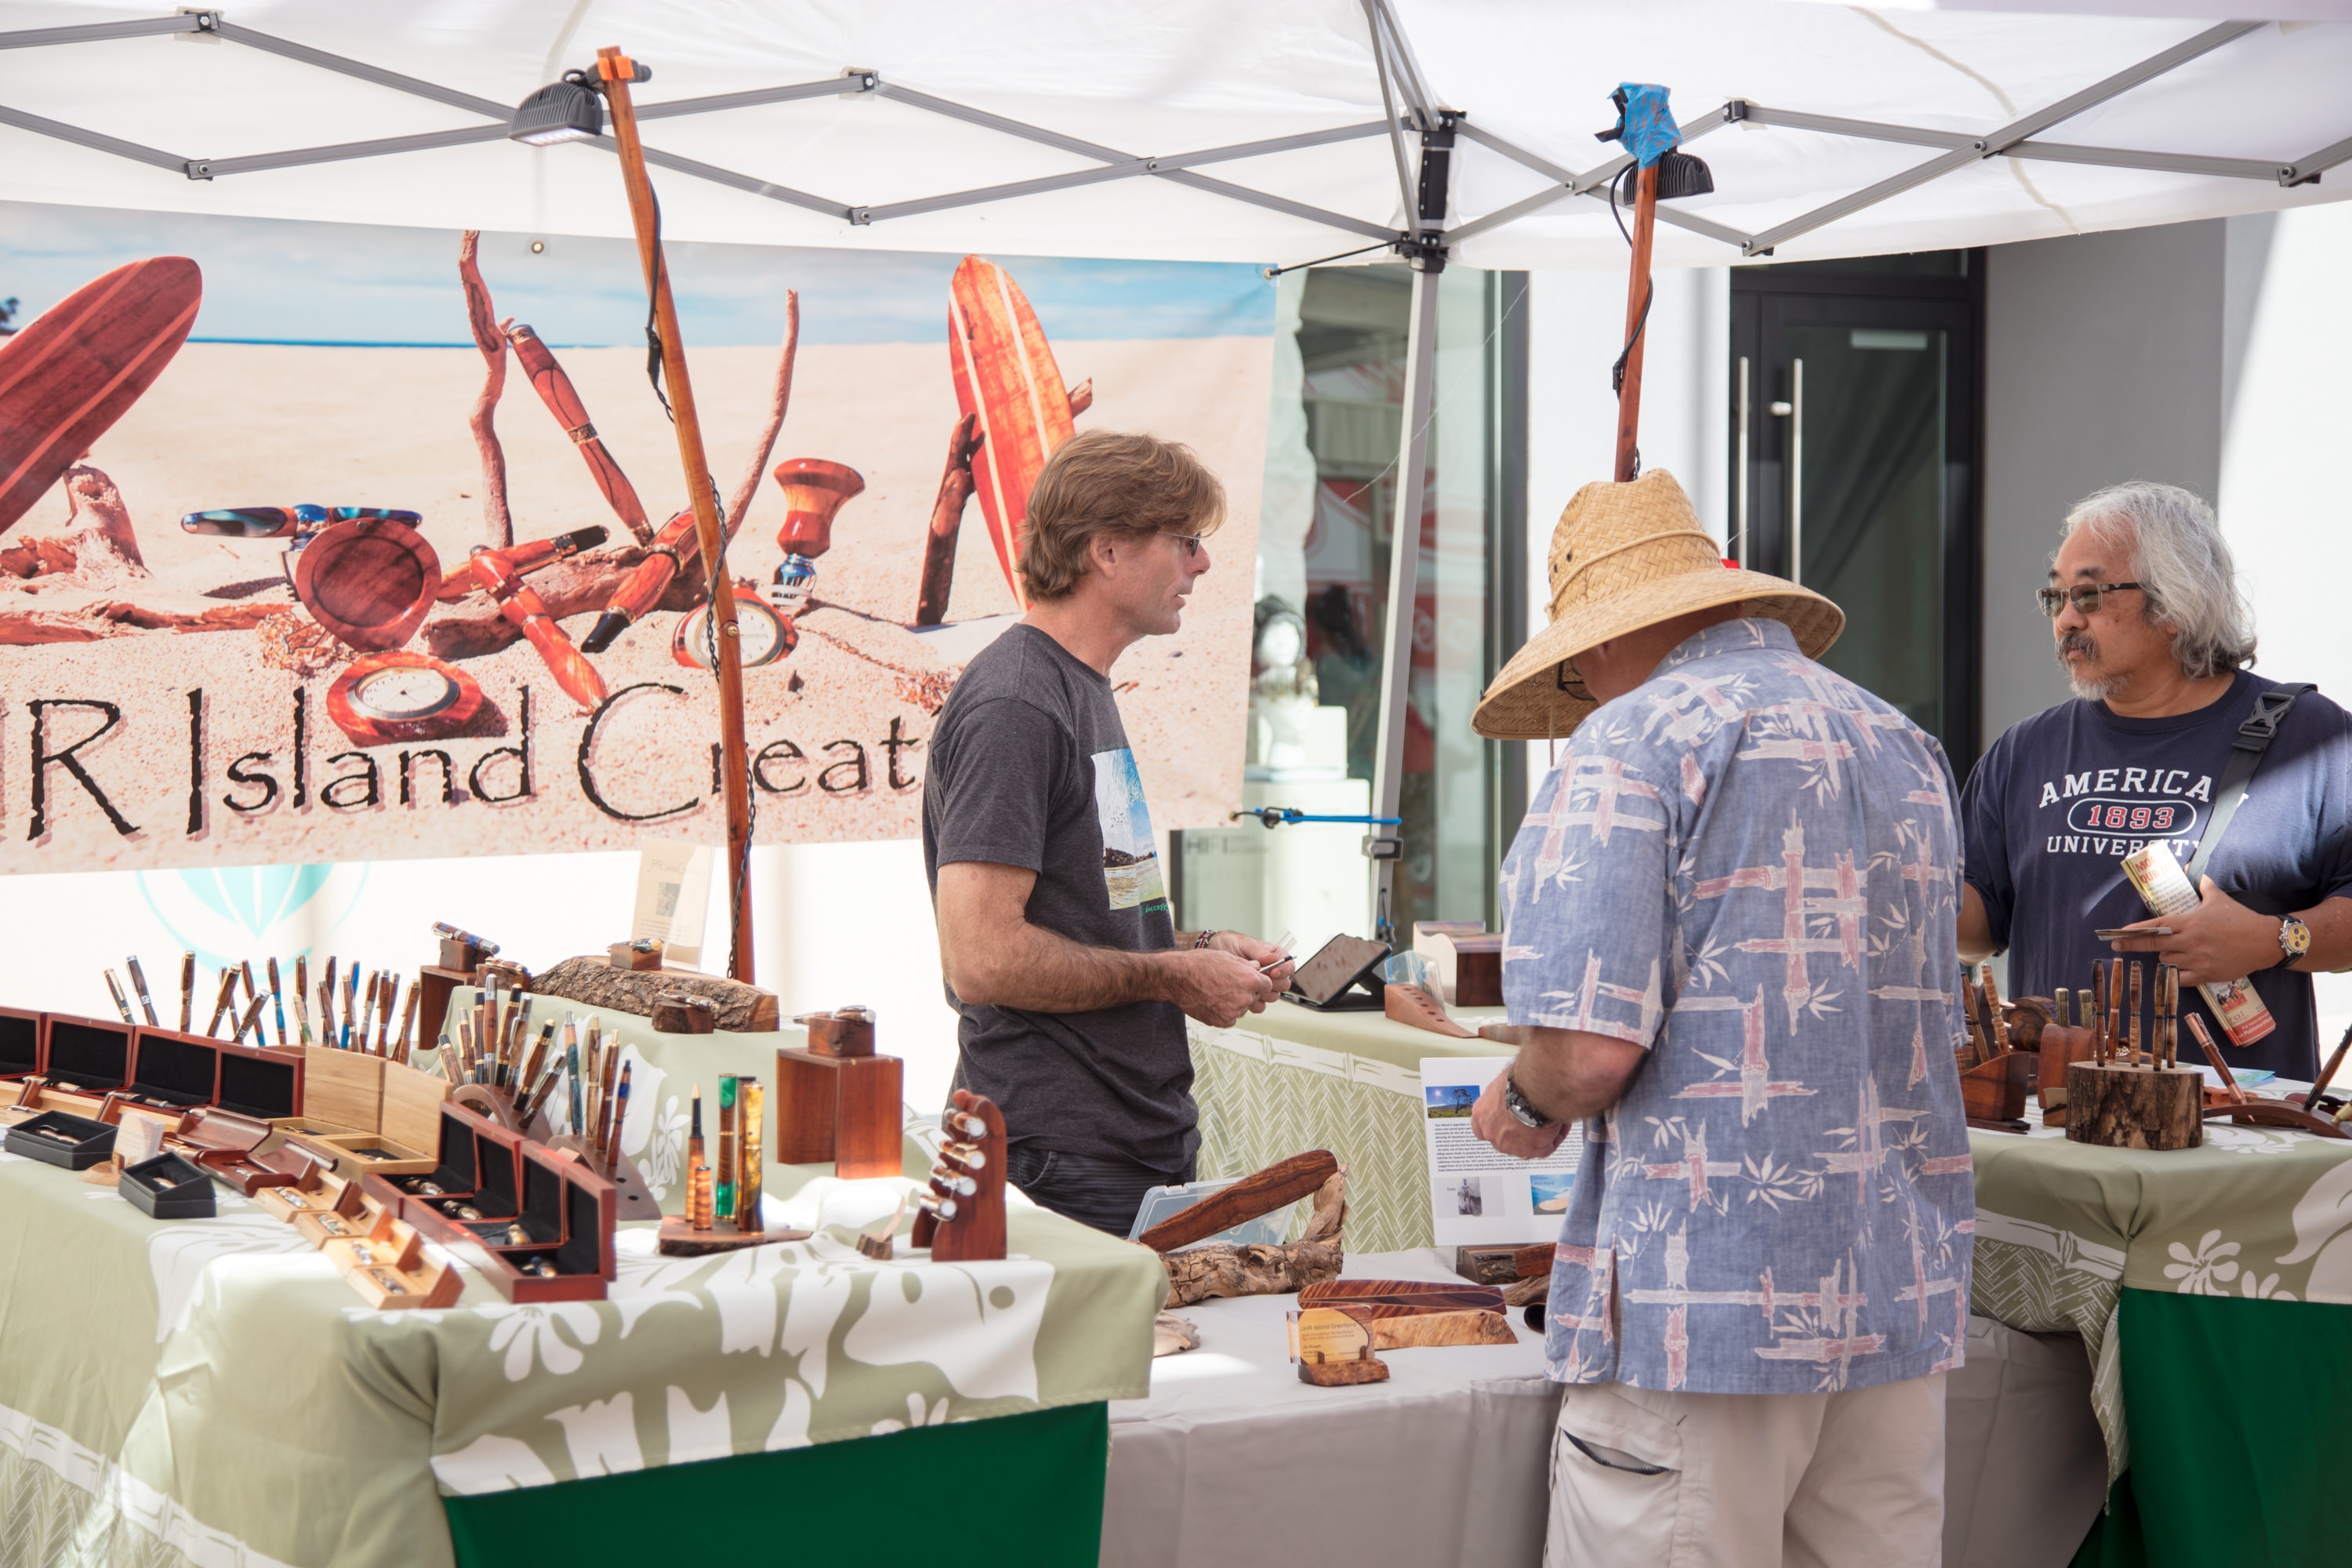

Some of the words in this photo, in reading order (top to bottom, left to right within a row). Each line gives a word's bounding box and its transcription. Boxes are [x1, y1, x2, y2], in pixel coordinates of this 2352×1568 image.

[187, 685, 532, 835] Island
[578, 681, 942, 822] Creat
[2039, 768, 2249, 808] AMERICA
[2087, 804, 2175, 829] 1893
[2046, 836, 2200, 856] UNIVERT
